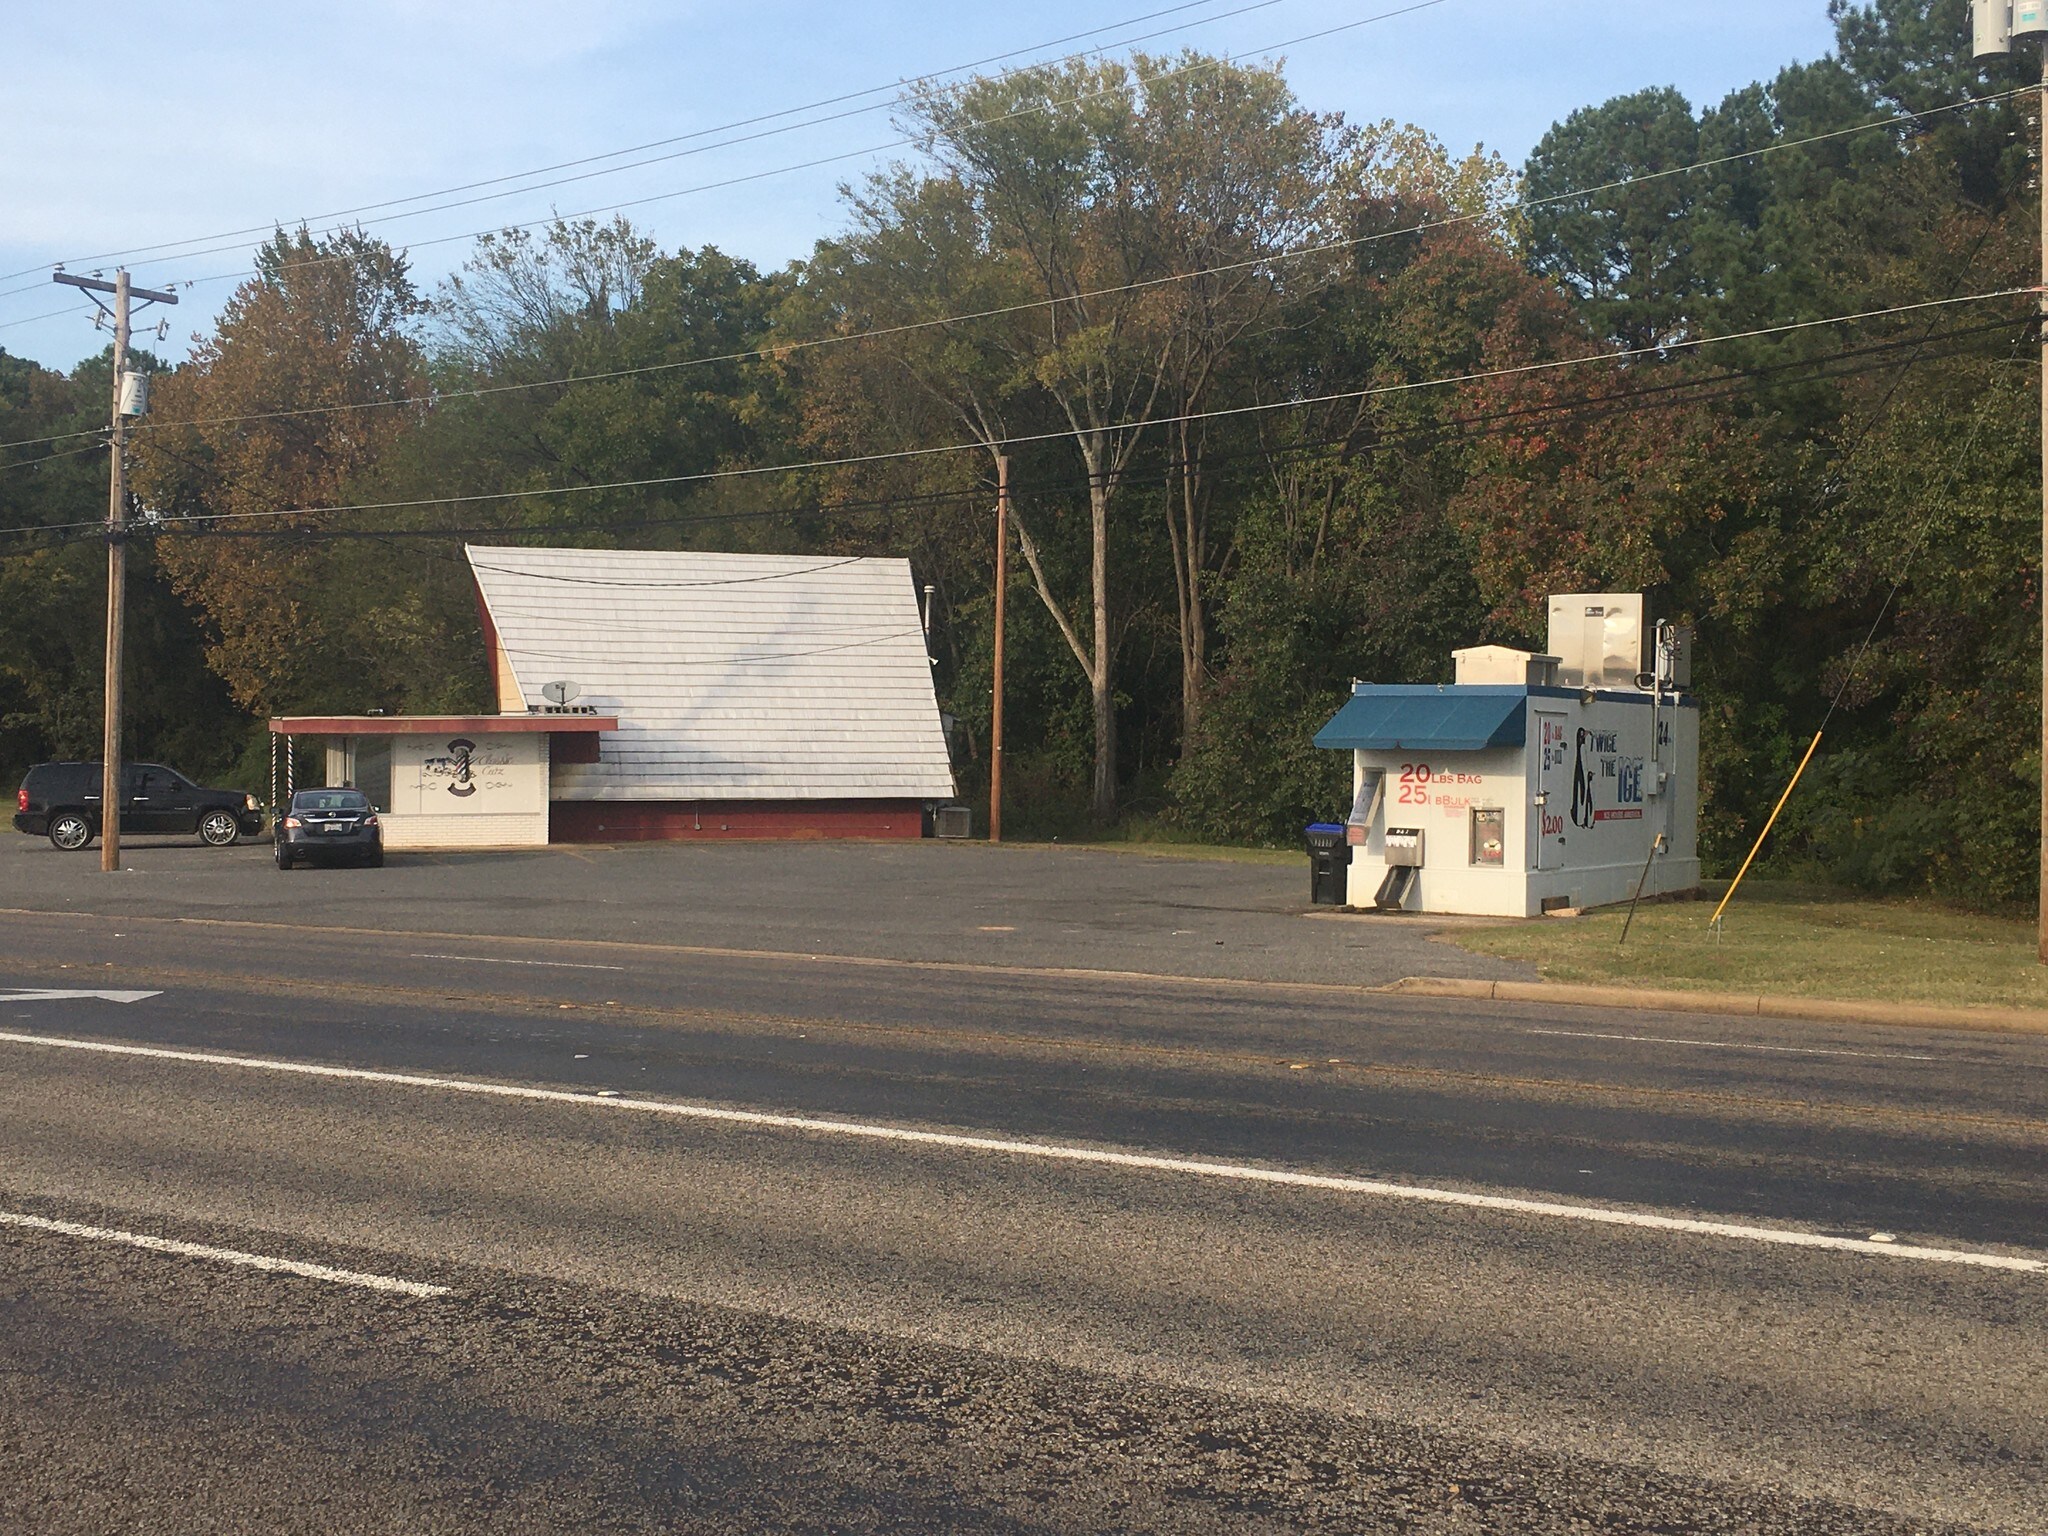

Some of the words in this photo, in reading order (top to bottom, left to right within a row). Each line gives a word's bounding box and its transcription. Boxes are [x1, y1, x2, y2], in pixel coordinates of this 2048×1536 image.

[1590, 729, 1617, 753] TWICE
[1399, 763, 1431, 783] 20
[1431, 774, 1454, 784] LBS
[1457, 773, 1482, 784] BAG
[1600, 756, 1616, 778] THE
[1618, 756, 1644, 803] ICE
[1398, 785, 1428, 805] 25
[1541, 807, 1563, 837] $2.00
